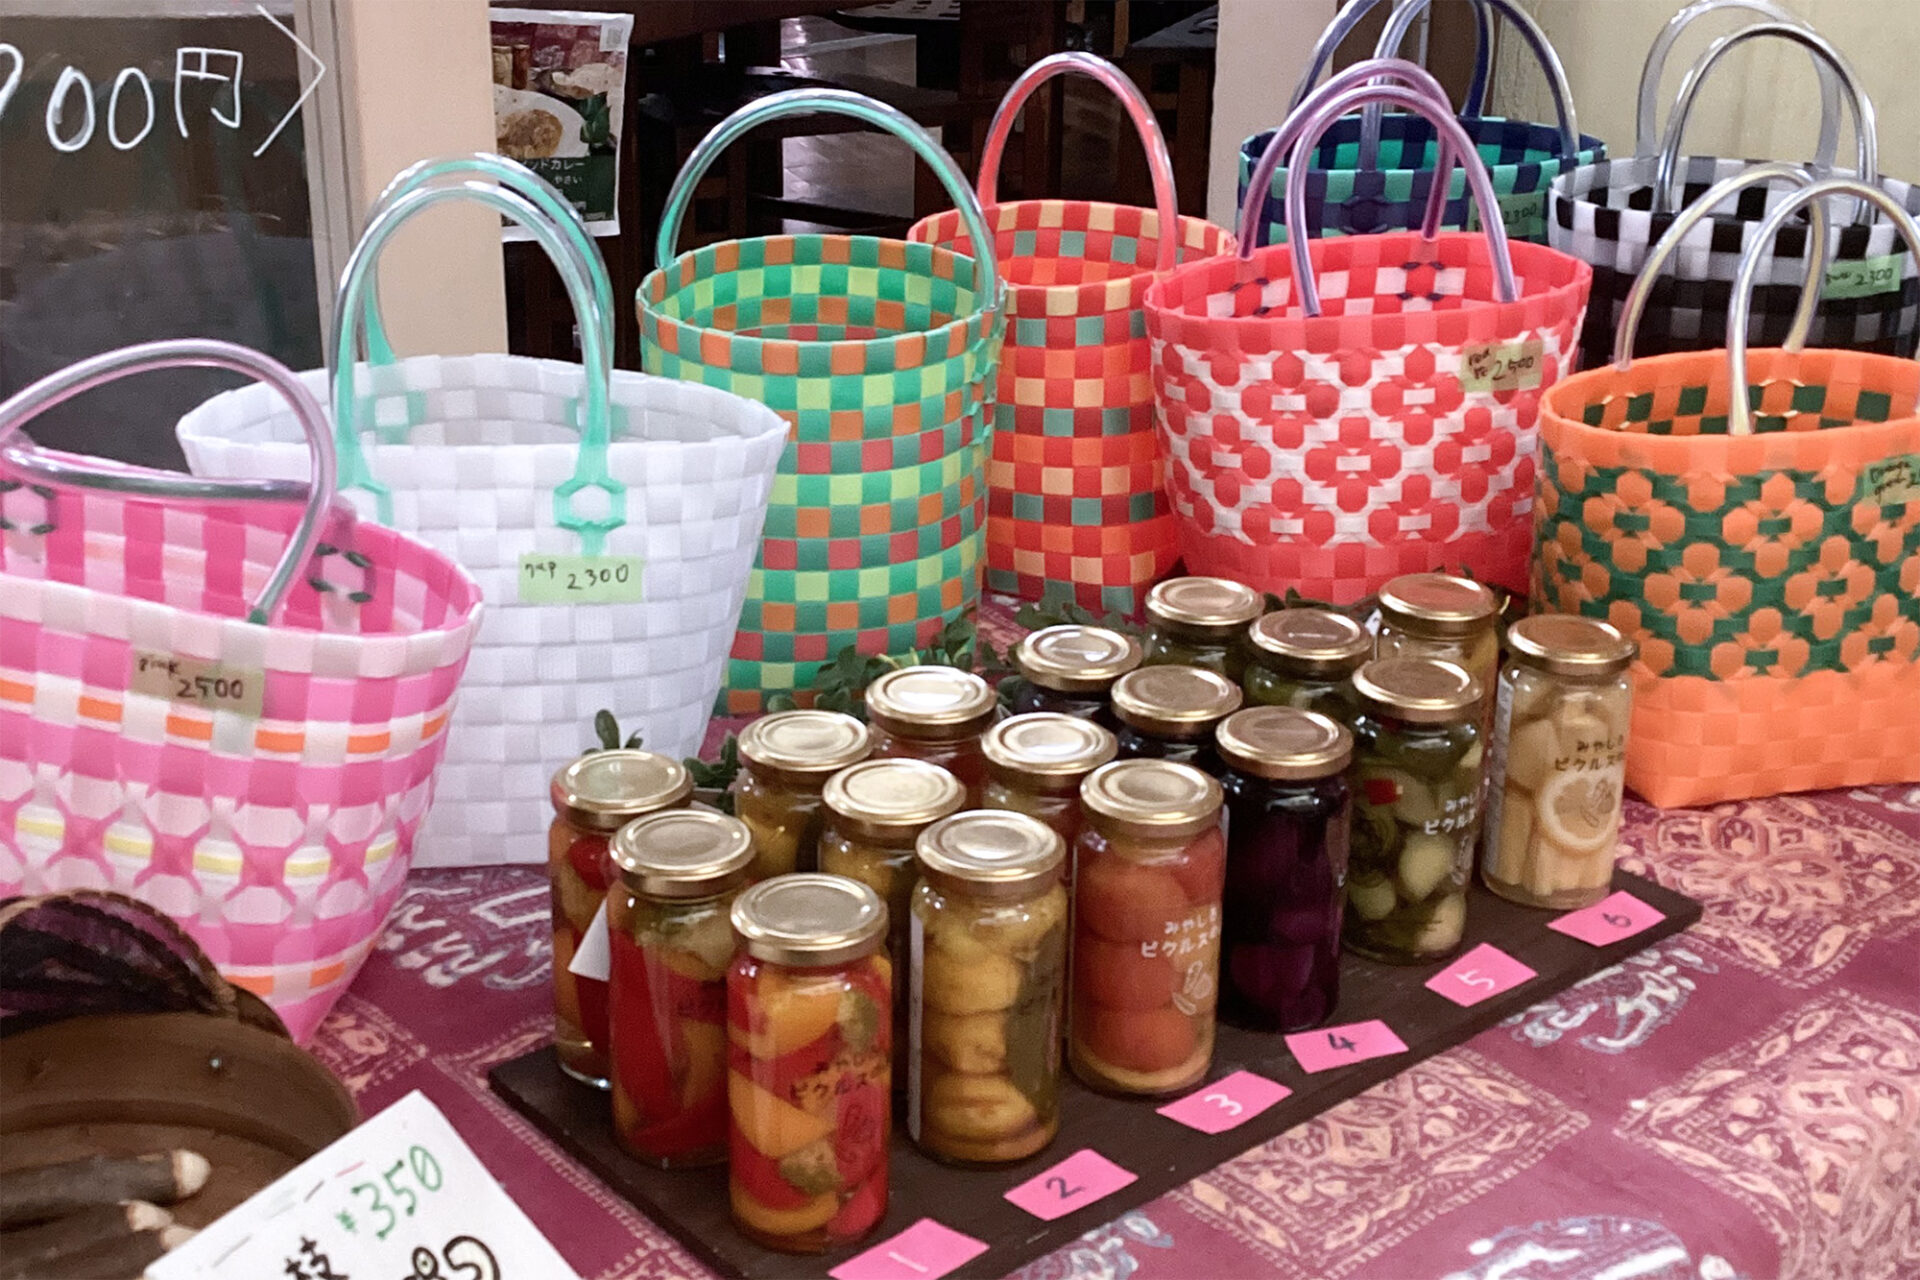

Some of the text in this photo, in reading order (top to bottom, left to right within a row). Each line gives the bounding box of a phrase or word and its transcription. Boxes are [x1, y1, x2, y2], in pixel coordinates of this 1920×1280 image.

[566, 563, 629, 590] 2300
[177, 675, 244, 700] 2500
[1454, 969, 1496, 992] 5
[1326, 1032, 1357, 1054] 4
[1203, 1093, 1243, 1117] 3
[335, 1145, 443, 1239] ¥350
[1045, 1175, 1085, 1200] 2
[887, 1250, 929, 1274] 1
